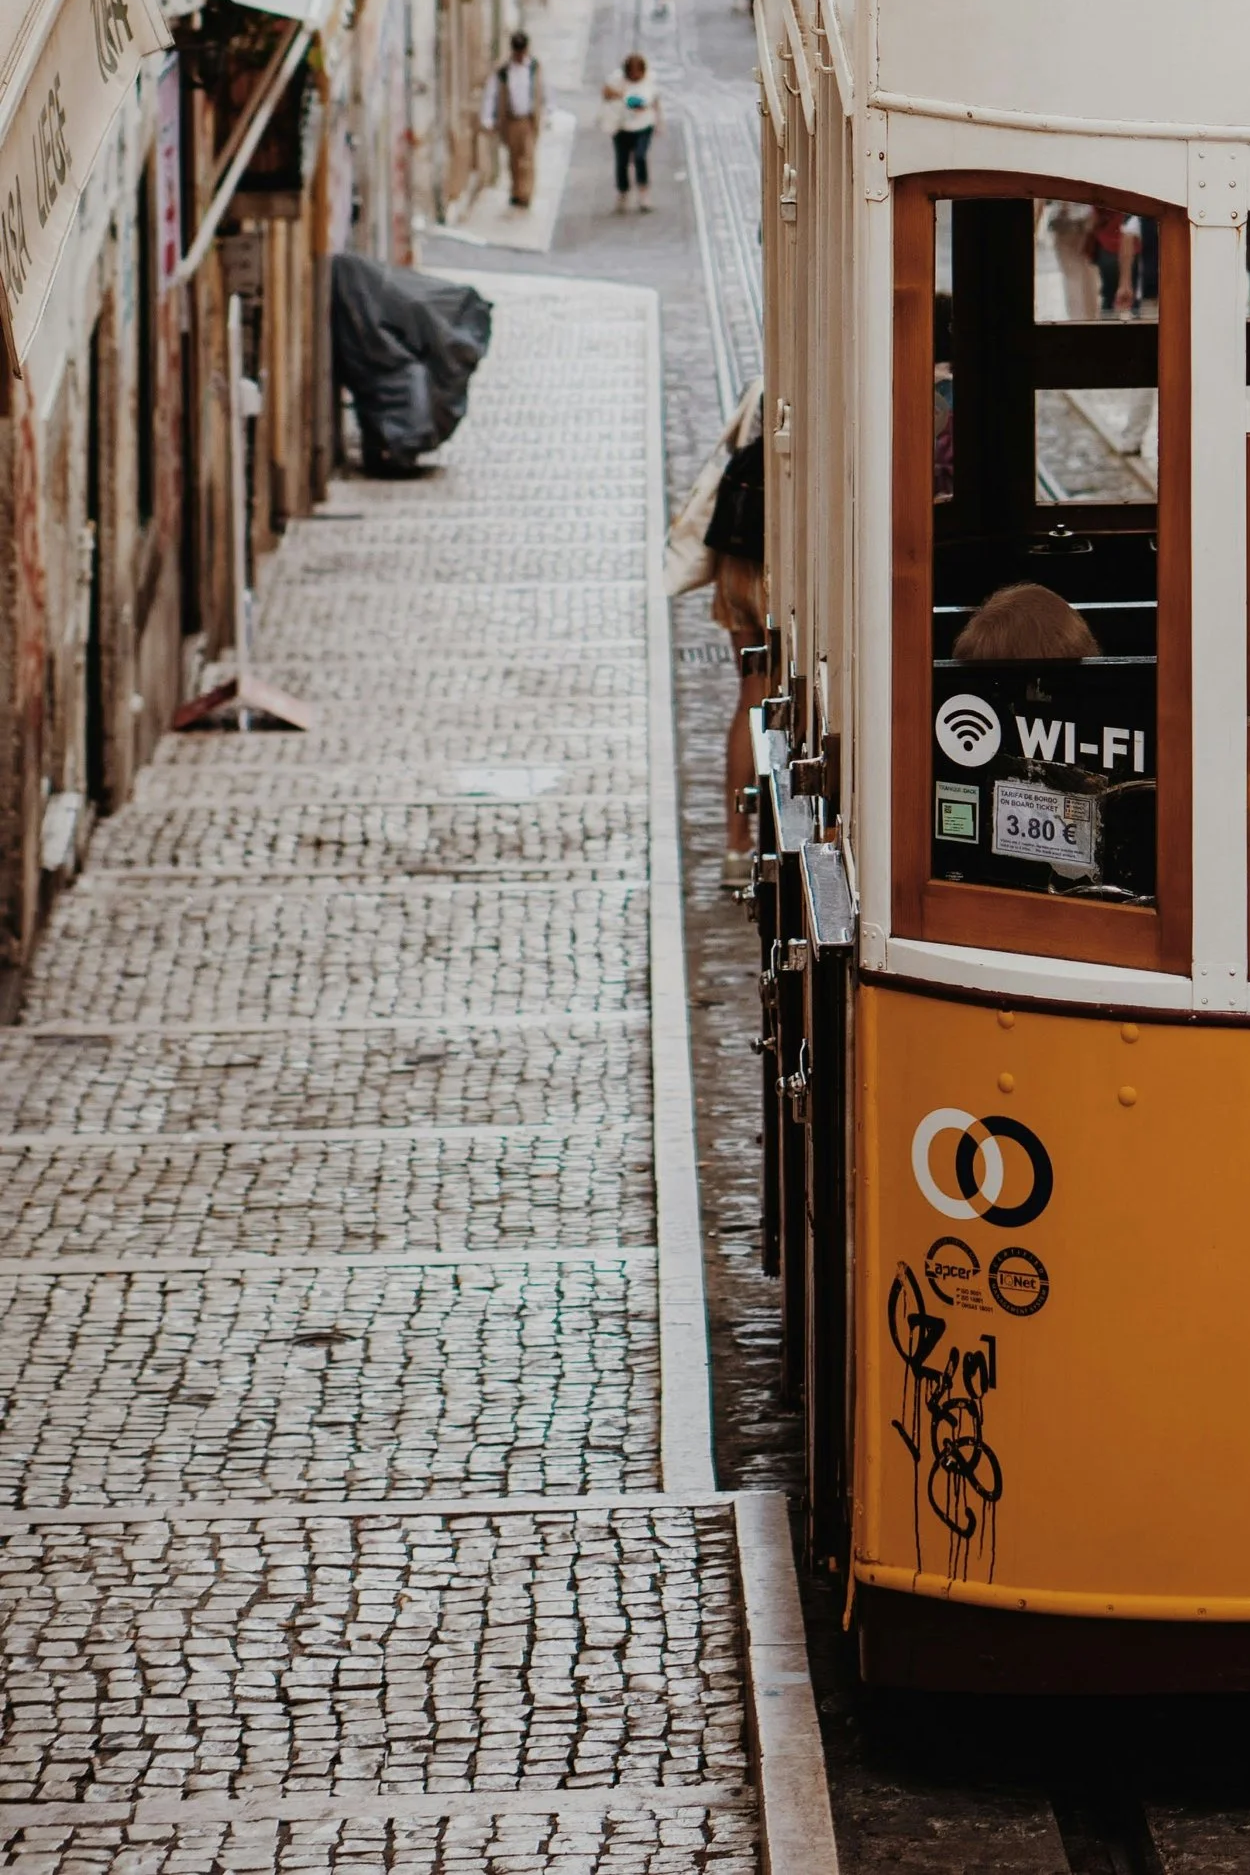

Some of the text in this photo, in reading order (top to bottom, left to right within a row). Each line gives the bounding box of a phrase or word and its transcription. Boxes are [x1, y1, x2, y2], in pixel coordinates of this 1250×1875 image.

[0, 173, 32, 305] ASA
[1015, 715, 1145, 773] WI-FI
[1000, 790, 1058, 804] TARIFA DE BORDO
[1000, 798, 1059, 813] ON BOARD TICKET
[1007, 814, 1077, 845] 3.80 €
[935, 1263, 971, 1280] apcer
